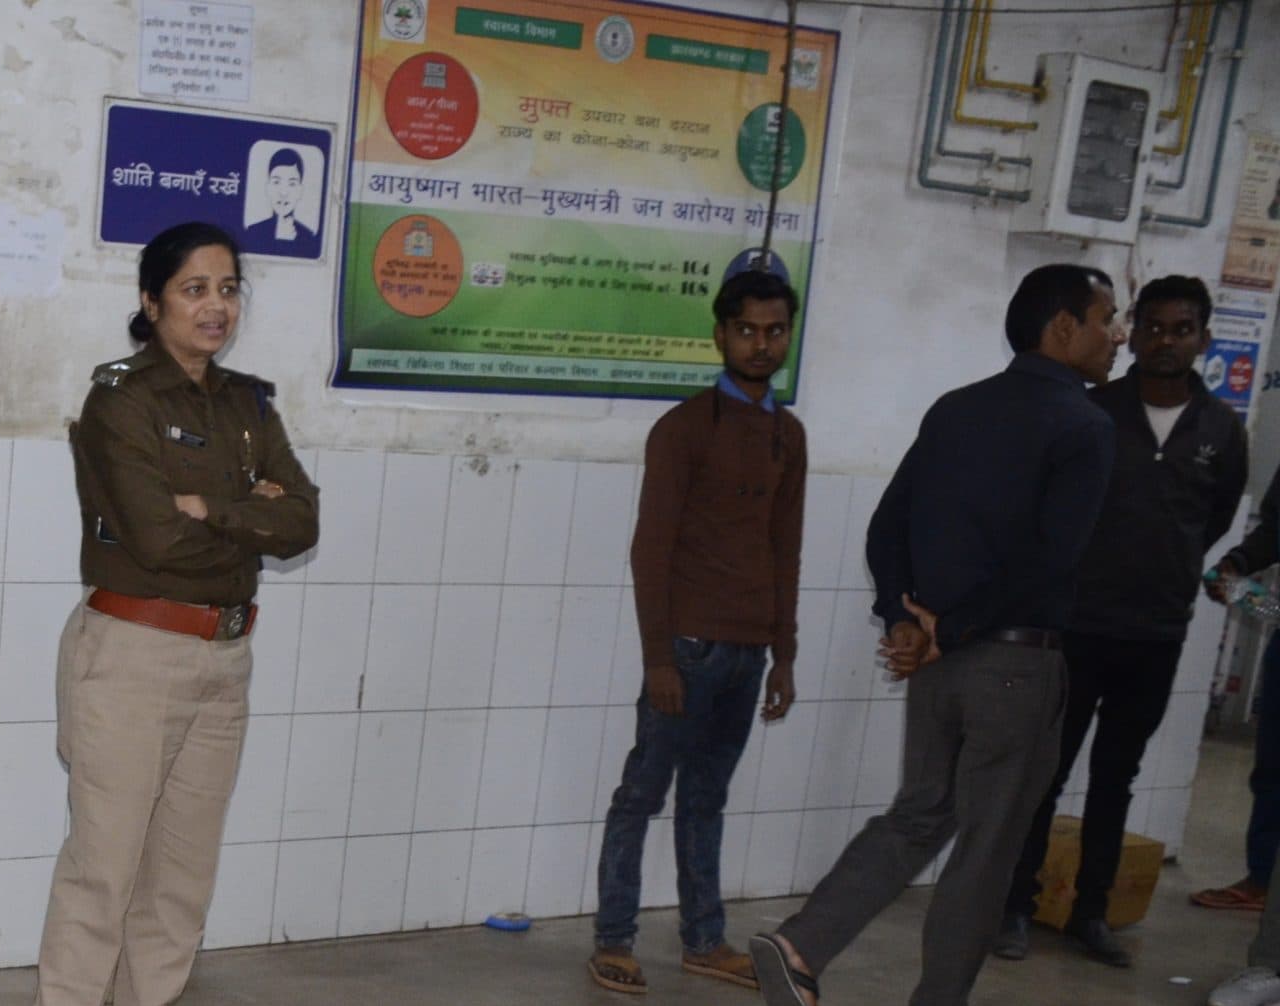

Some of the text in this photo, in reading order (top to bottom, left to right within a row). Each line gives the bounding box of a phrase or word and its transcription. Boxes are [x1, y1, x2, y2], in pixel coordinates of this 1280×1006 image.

[112, 161, 241, 197] शांति बनाएँ रखें
[369, 173, 461, 204] आयुष्मान
[632, 196, 663, 218] जन
[673, 198, 737, 225] आरोग्य
